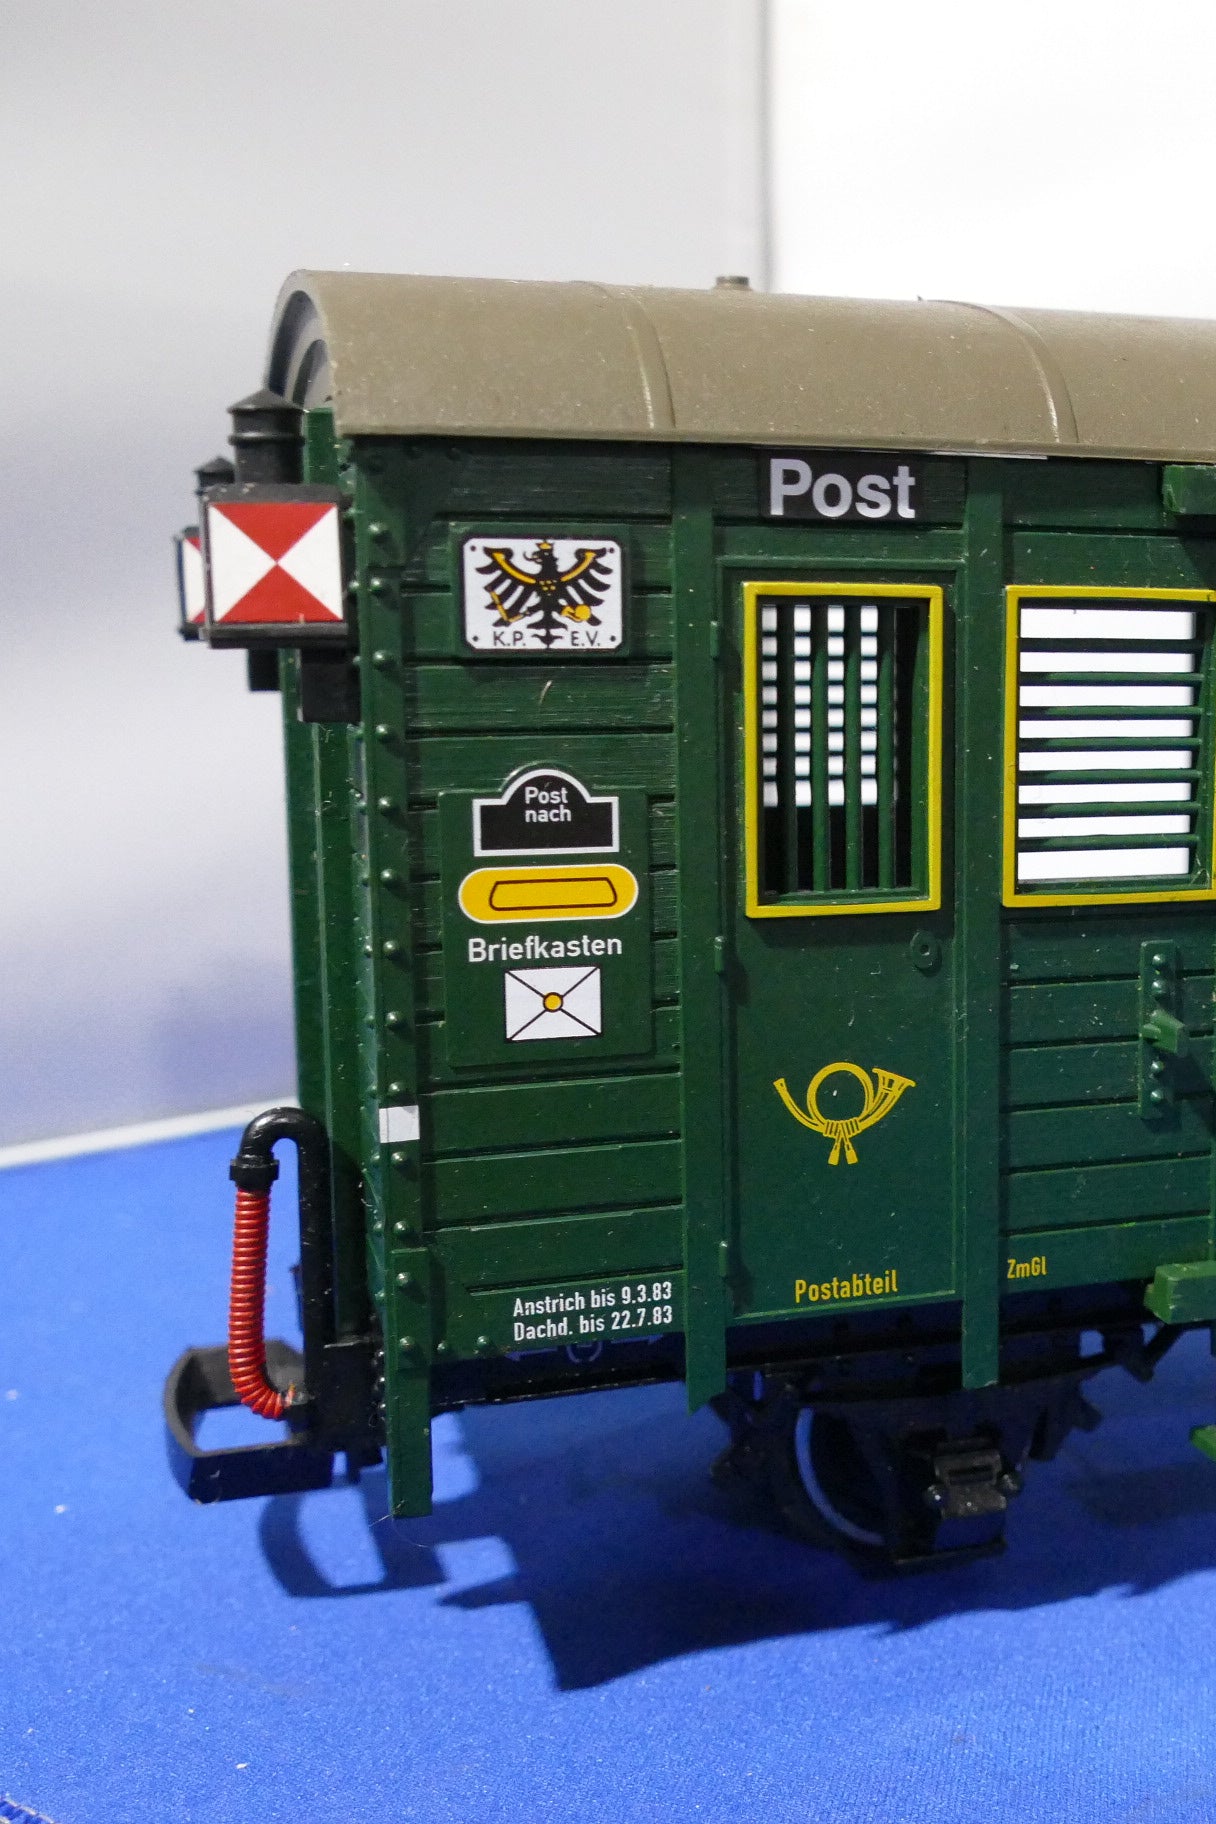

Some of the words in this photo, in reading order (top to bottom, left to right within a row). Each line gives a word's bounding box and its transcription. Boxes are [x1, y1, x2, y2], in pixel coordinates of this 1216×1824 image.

[770, 458, 916, 519] Post
[493, 631, 526, 647] K.P.
[571, 630, 601, 647] E.V.
[524, 786, 568, 804] Post
[525, 804, 572, 823] nach
[468, 934, 623, 963] Briefkasten
[513, 1291, 586, 1317] Anstrich
[590, 1287, 616, 1309] bis
[621, 1281, 672, 1305] 9.3.83
[795, 1269, 898, 1304] Postabteil
[513, 1317, 574, 1342] Dachd.
[579, 1314, 605, 1334] bis
[611, 1305, 673, 1331] 22.7.83
